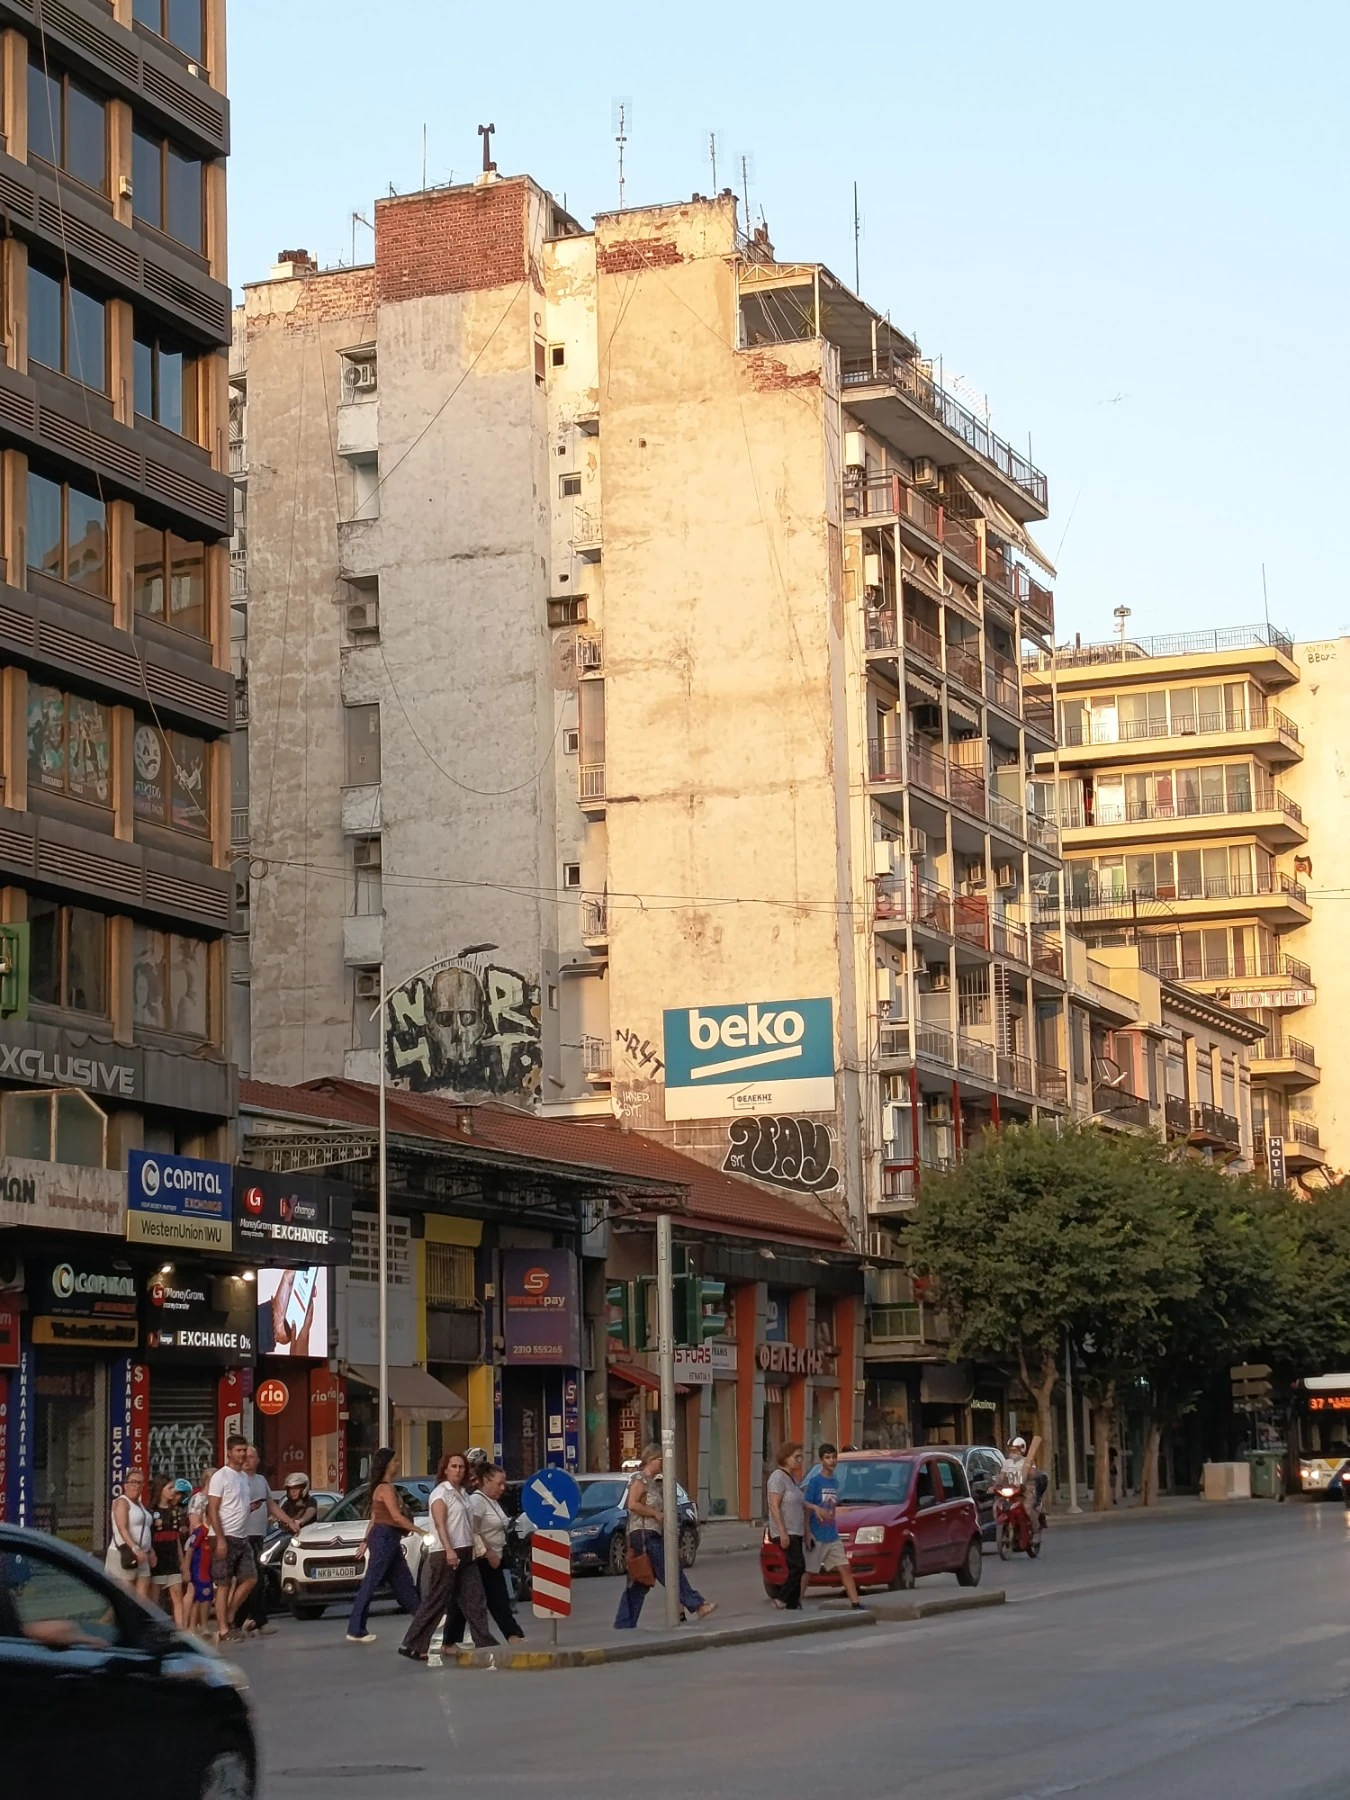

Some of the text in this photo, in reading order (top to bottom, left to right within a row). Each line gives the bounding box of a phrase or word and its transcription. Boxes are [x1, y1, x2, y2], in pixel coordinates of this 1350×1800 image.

[1232, 991, 1313, 1008] HOTEL
[689, 1004, 805, 1050] beko
[273, 1224, 329, 1245] EXCHANGE
[180, 1331, 237, 1349] EXCHANGE
[760, 1345, 823, 1374] ΦΕΛΕΚΗΣ
[260, 1384, 284, 1402] ria
[311, 1390, 327, 1402] ria
[1310, 1398, 1324, 1410] 37
